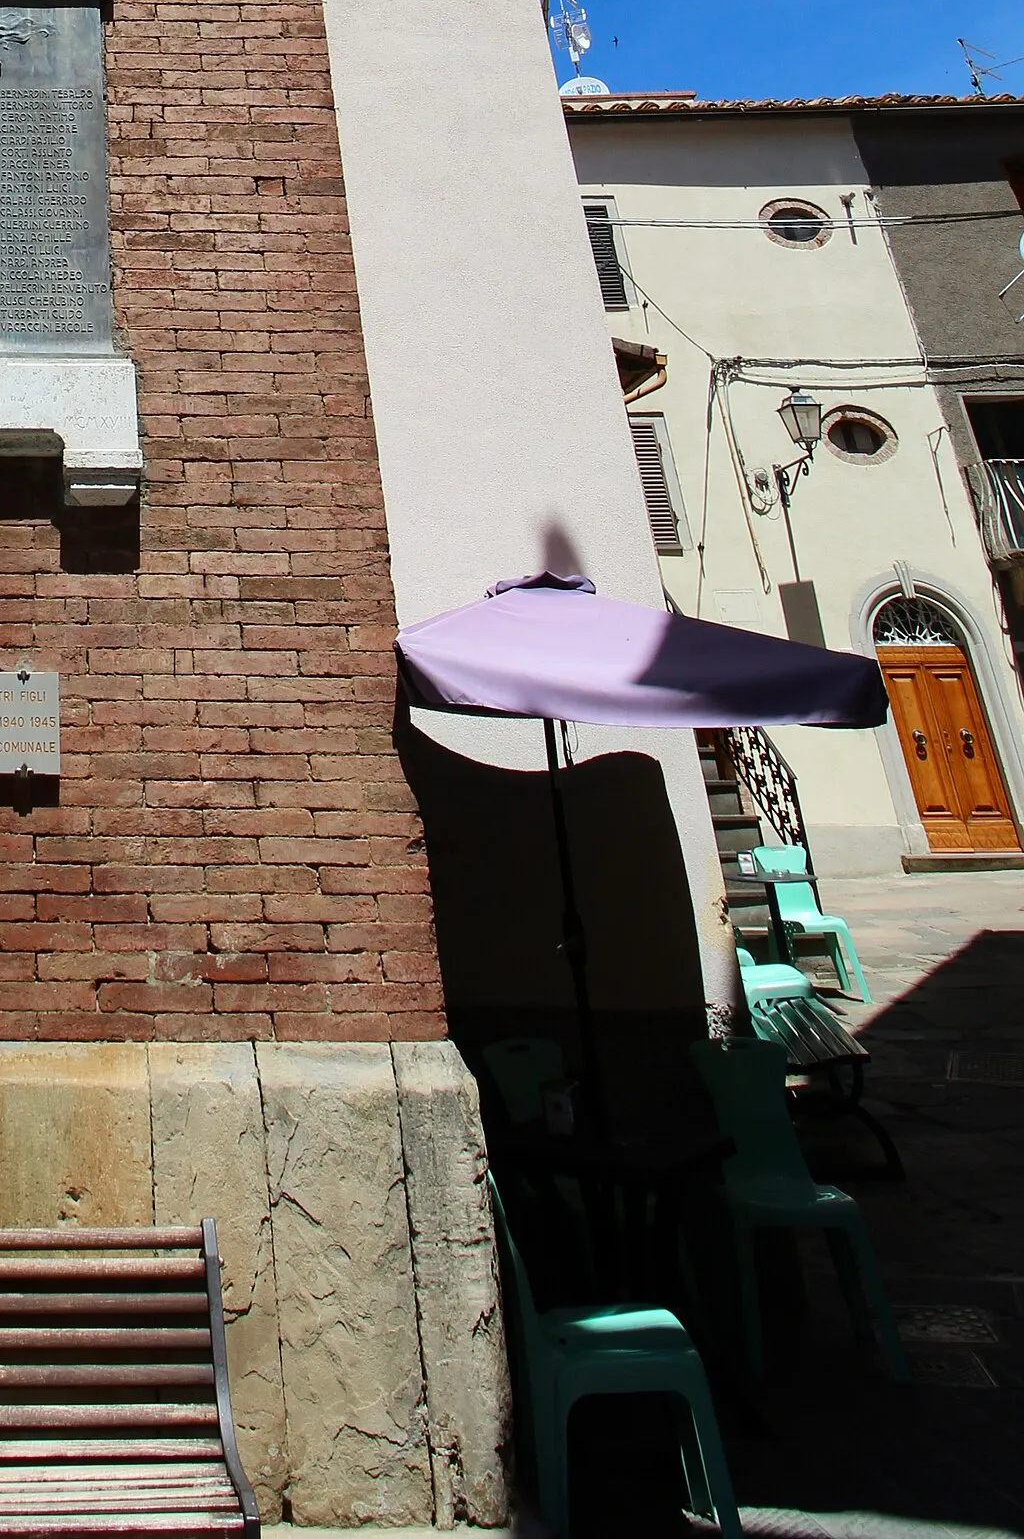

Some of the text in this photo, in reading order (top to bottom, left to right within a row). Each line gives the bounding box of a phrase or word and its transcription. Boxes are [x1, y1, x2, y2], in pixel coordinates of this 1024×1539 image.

[1, 89, 50, 99] BERNARDINI
[51, 89, 93, 99] TEBALDO
[0, 101, 94, 110] BERNARDINI VITTORIO
[1, 112, 35, 122] CERONI
[39, 112, 75, 121] ANTIMO
[27, 124, 78, 133] ANTENORE
[1, 136, 29, 145] CIARDI
[31, 136, 65, 144] BASILIO
[1, 148, 72, 158] CORTI ASSUNTO
[43, 160, 70, 169] ENEA
[1, 171, 89, 180] FANTONI ANTONIO
[1, 183, 43, 193] FANTONI
[0, 232, 28, 242] LENZI
[31, 232, 72, 242] ACHILLE
[0, 245, 37, 255] MONACI
[0, 258, 69, 267] NARDI ANDREA
[0, 270, 83, 280] NICCOLAI AMEDEO
[51, 283, 107, 293] BENVENUTO
[0, 296, 84, 306] RUSCI CHERUBINO
[0, 309, 50, 319] TURBANTI
[55, 322, 93, 332] ERCOLE
[63, 415, 131, 429] MCMXVIII
[20, 691, 46, 702] FIGLI
[0, 716, 24, 728] 1940
[30, 716, 56, 728] 1945
